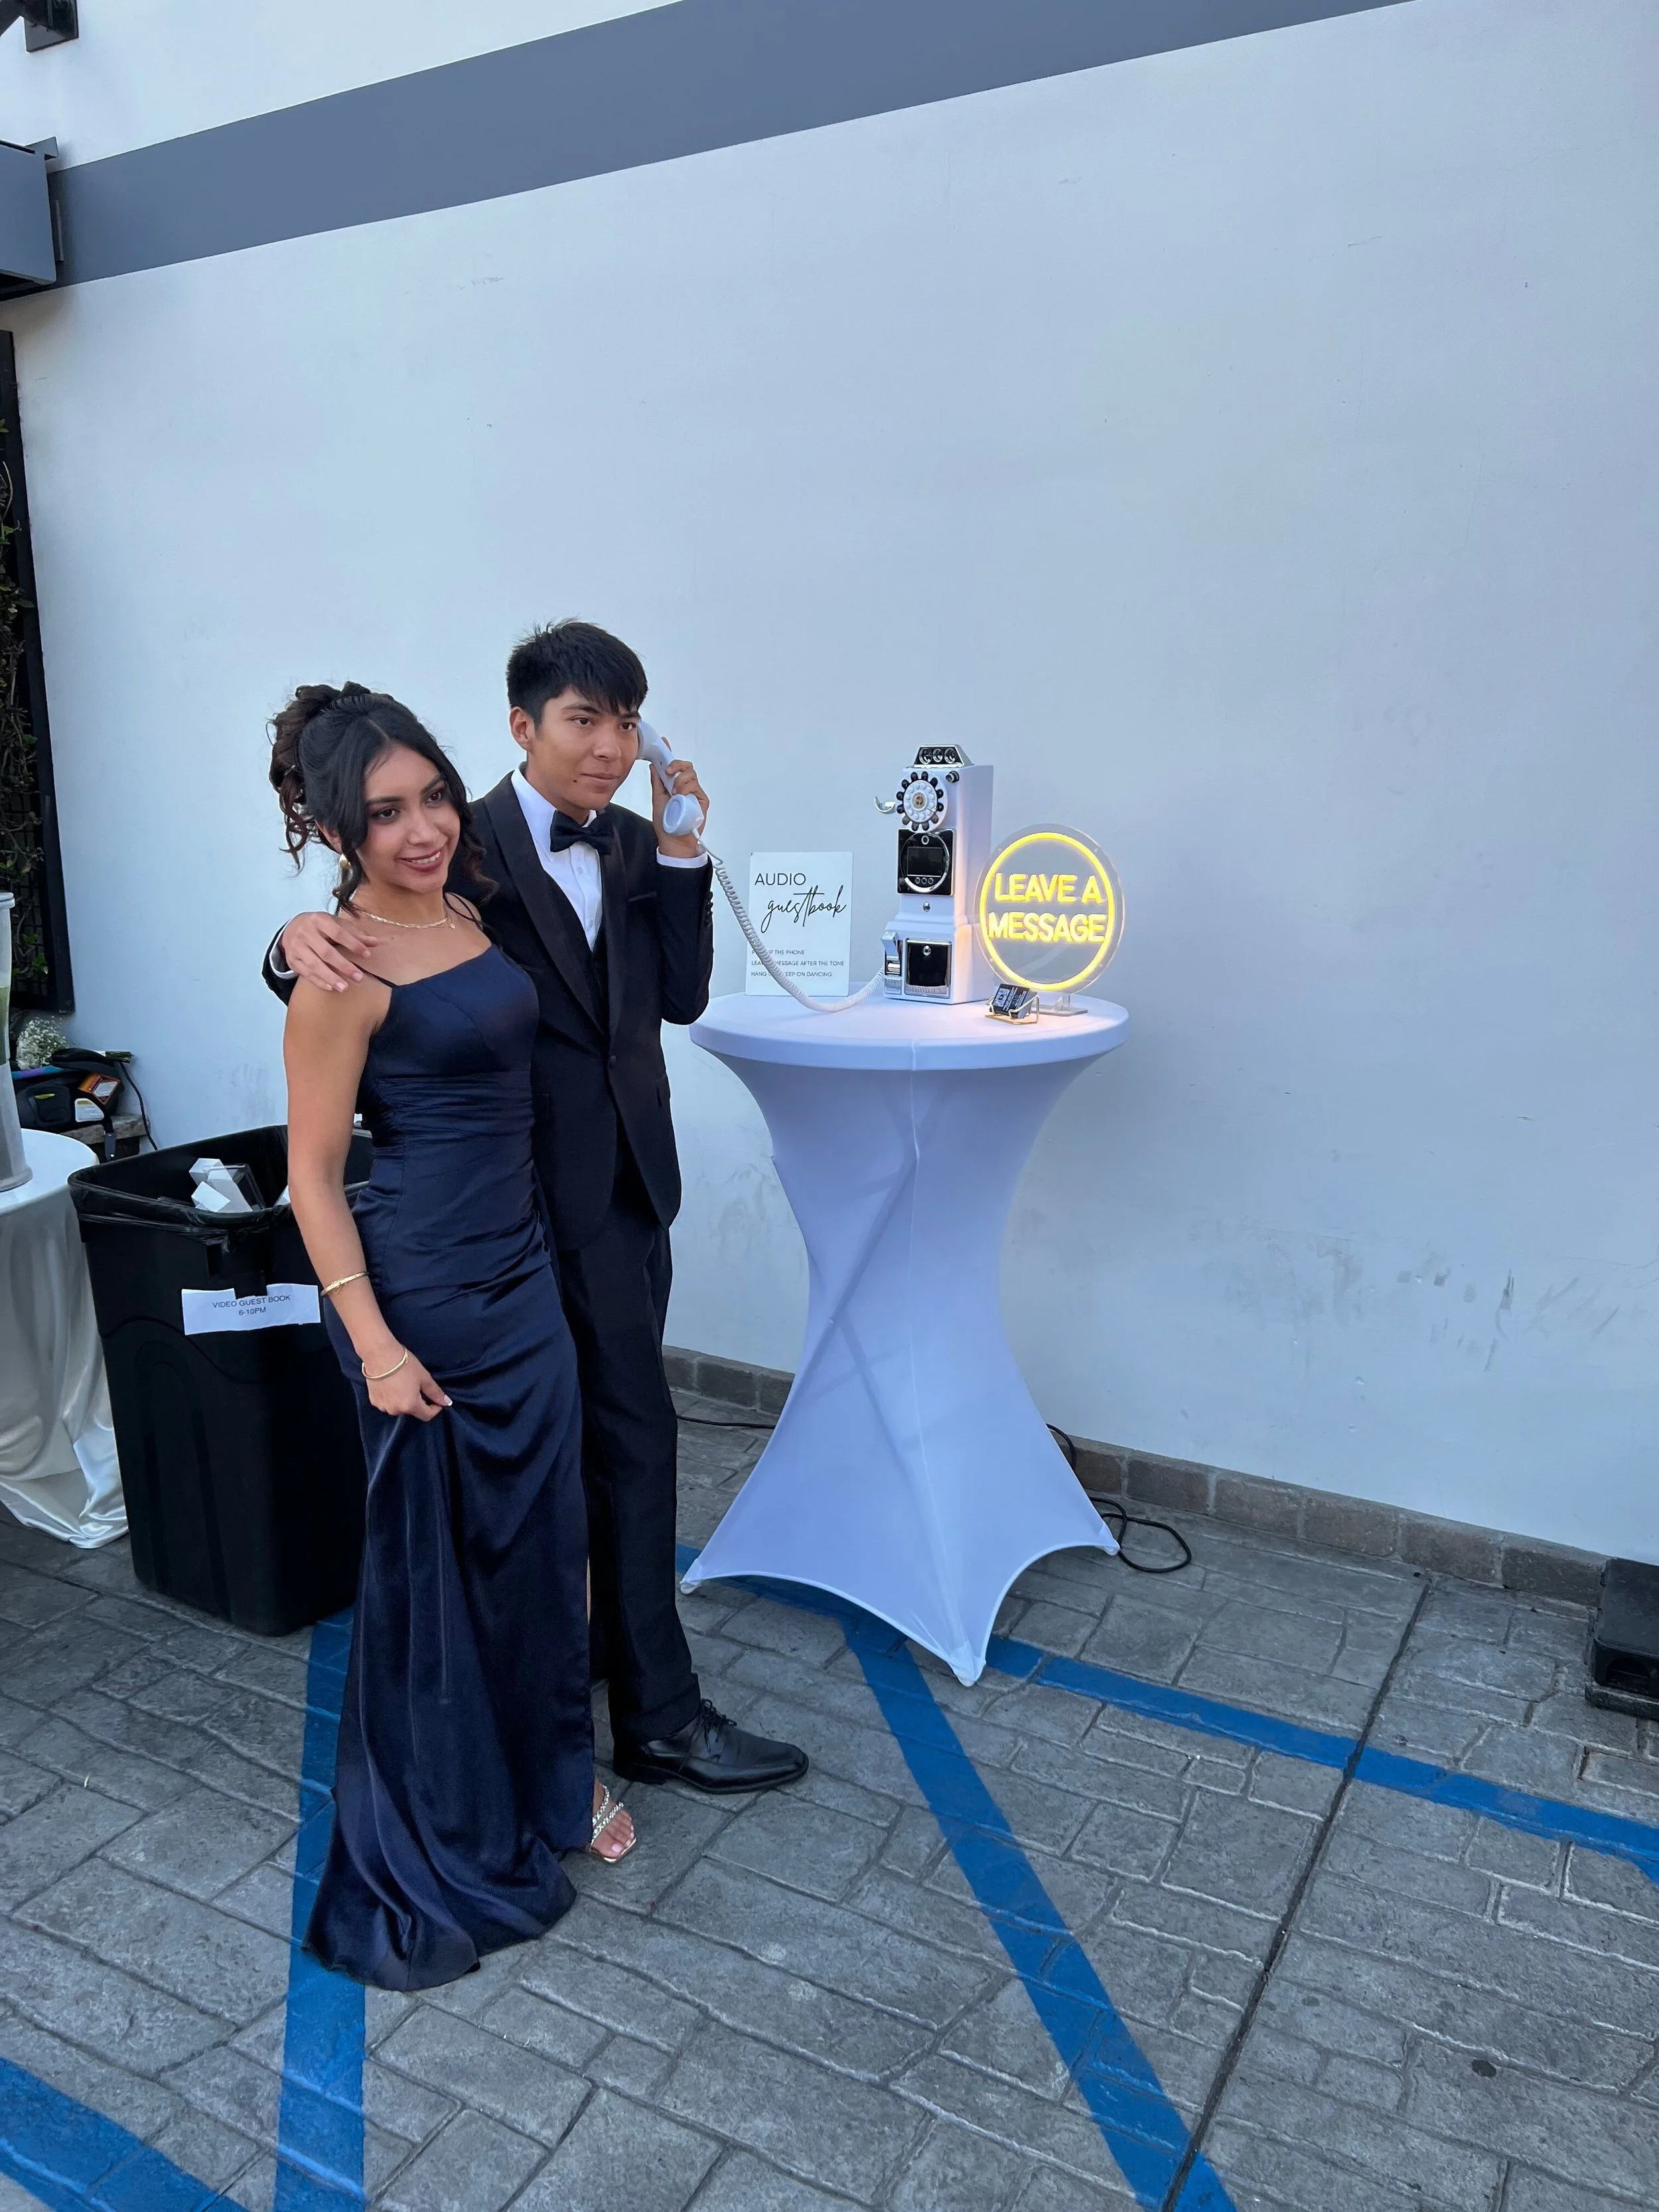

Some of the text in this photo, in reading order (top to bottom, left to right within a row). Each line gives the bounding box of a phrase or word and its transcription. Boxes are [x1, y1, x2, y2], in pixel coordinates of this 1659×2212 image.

[755, 873, 806, 885] AUDIO
[995, 872, 1103, 904] LEAVE A
[760, 885, 847, 933] guestbook
[987, 911, 1107, 942] MESSAGE
[212, 1299, 237, 1308] VIDEO
[238, 1307, 266, 1315] 6-10PM
